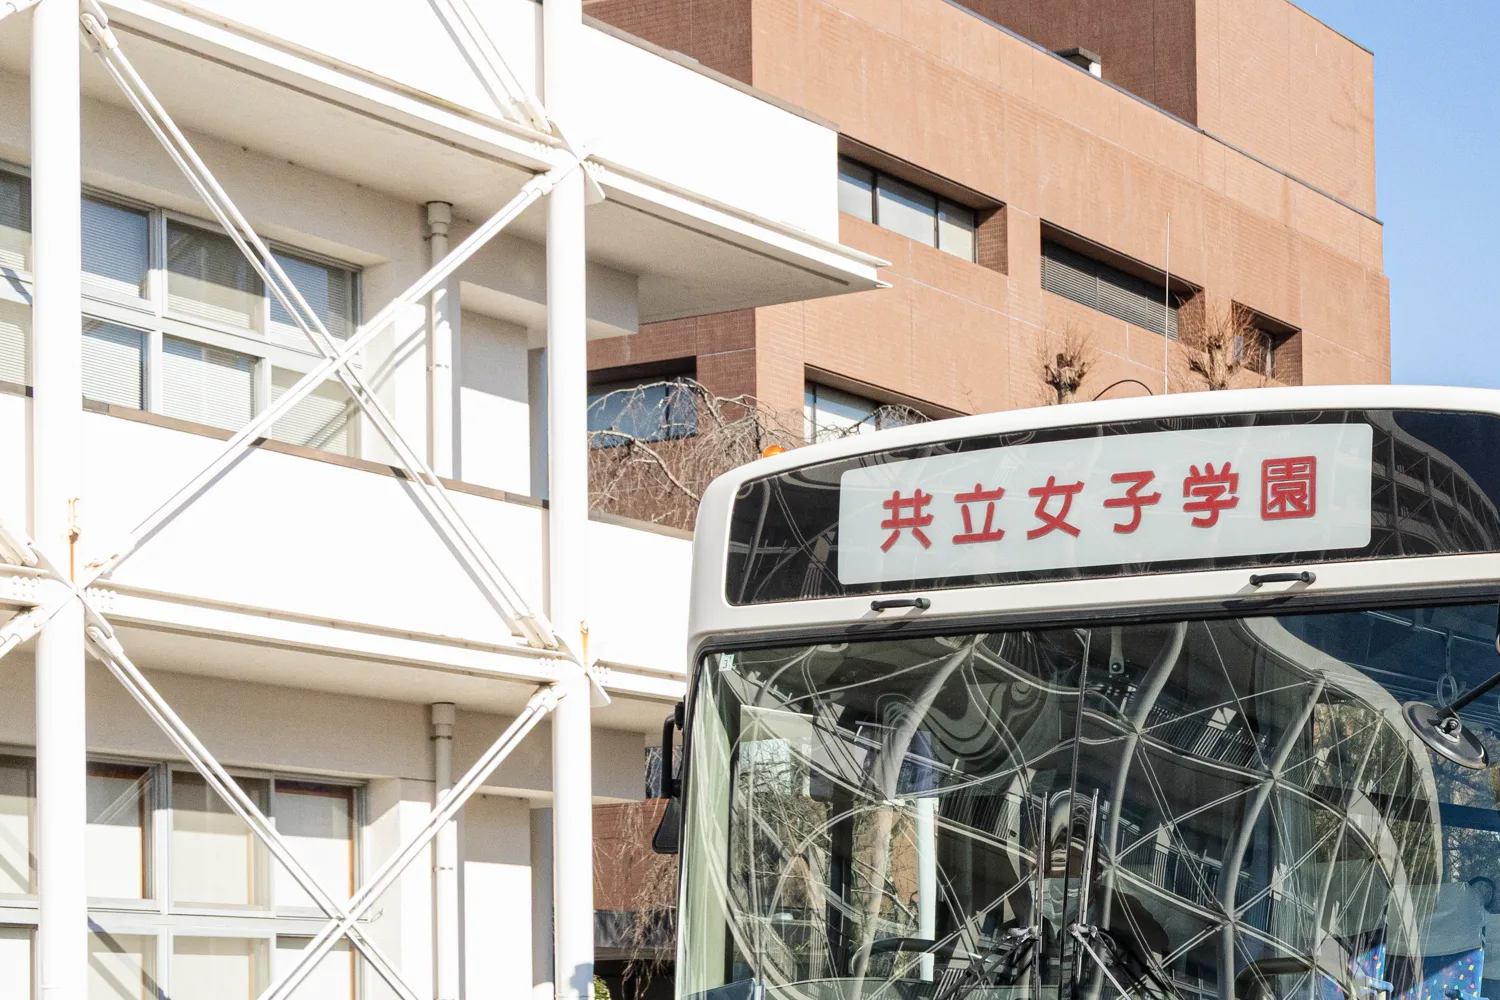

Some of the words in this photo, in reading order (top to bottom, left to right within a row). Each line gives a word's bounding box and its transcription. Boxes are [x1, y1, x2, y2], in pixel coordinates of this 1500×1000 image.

[880, 454, 1319, 554] 共立女子学園
